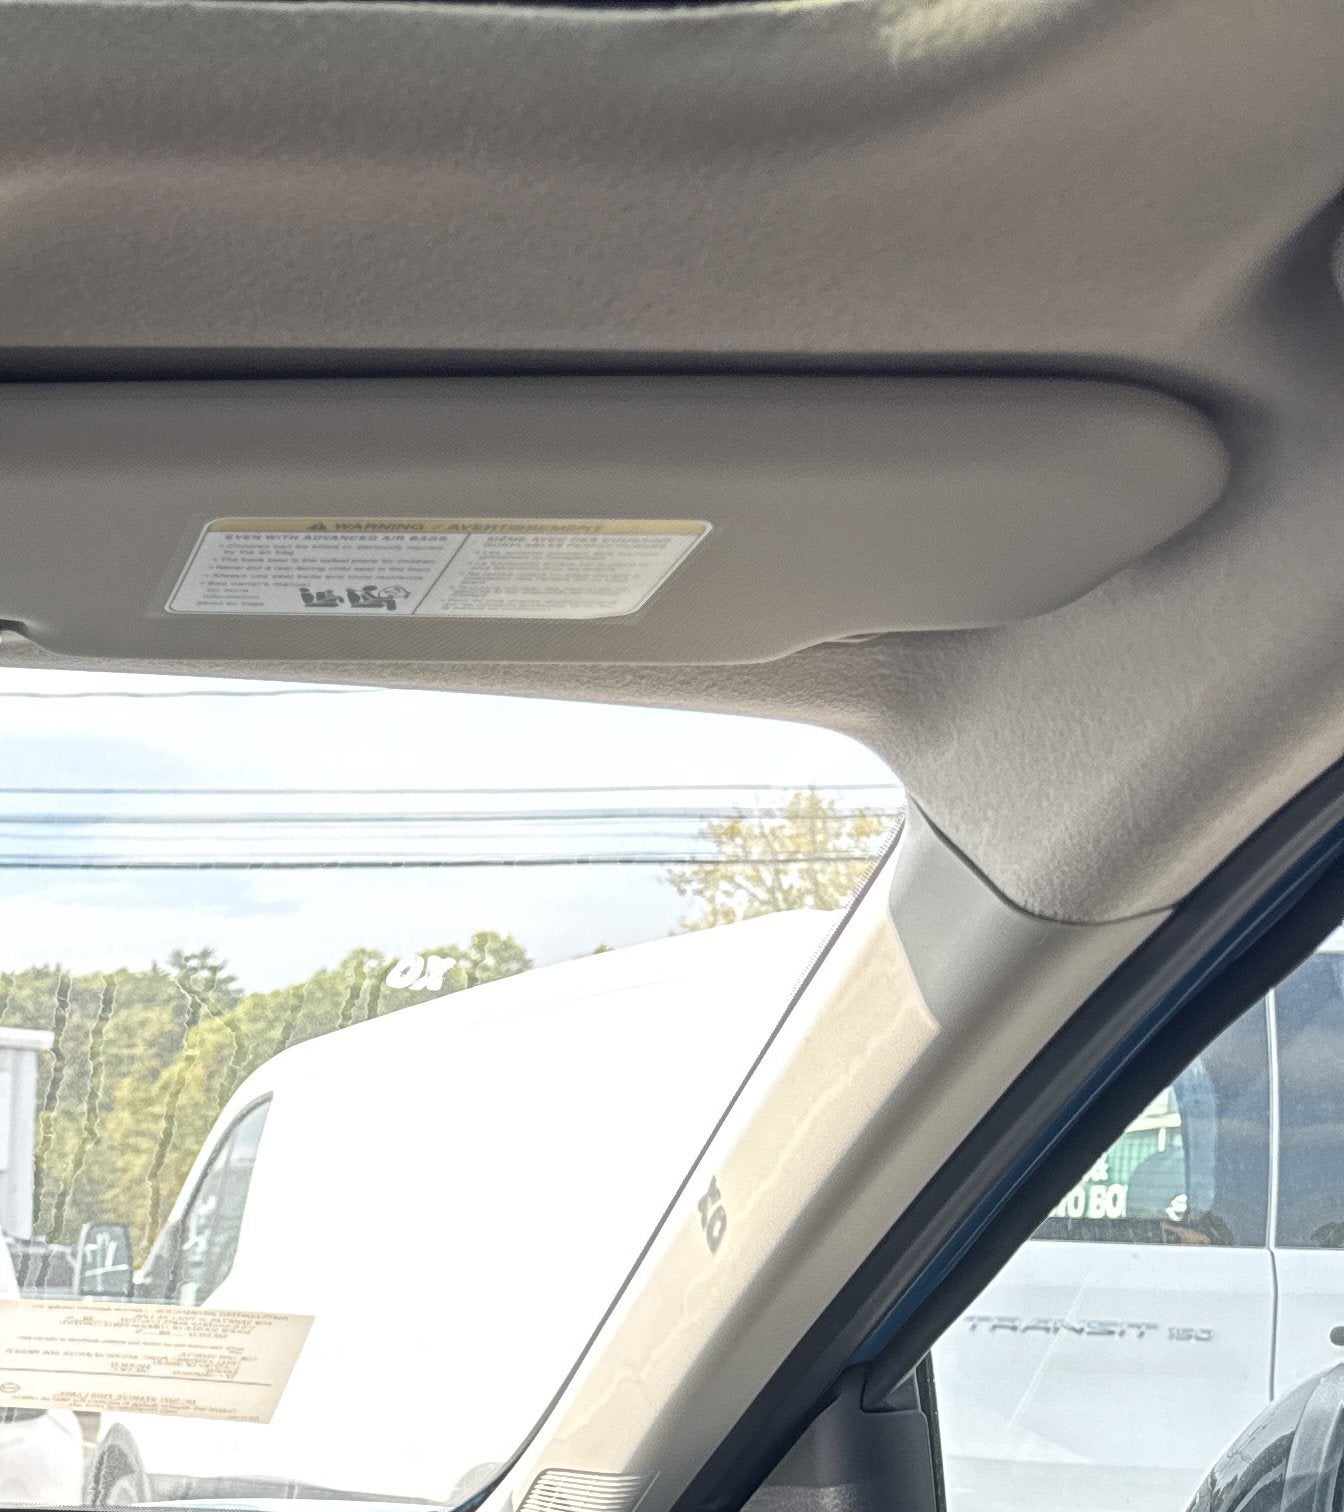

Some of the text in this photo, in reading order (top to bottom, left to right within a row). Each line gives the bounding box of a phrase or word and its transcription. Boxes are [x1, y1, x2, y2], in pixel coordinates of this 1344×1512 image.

[334, 522, 425, 532] WARNING
[225, 534, 262, 542] EVEN
[266, 534, 300, 542] WITH
[303, 534, 379, 542] ADVANCED
[963, 1315, 1159, 1338] TRANSIT
